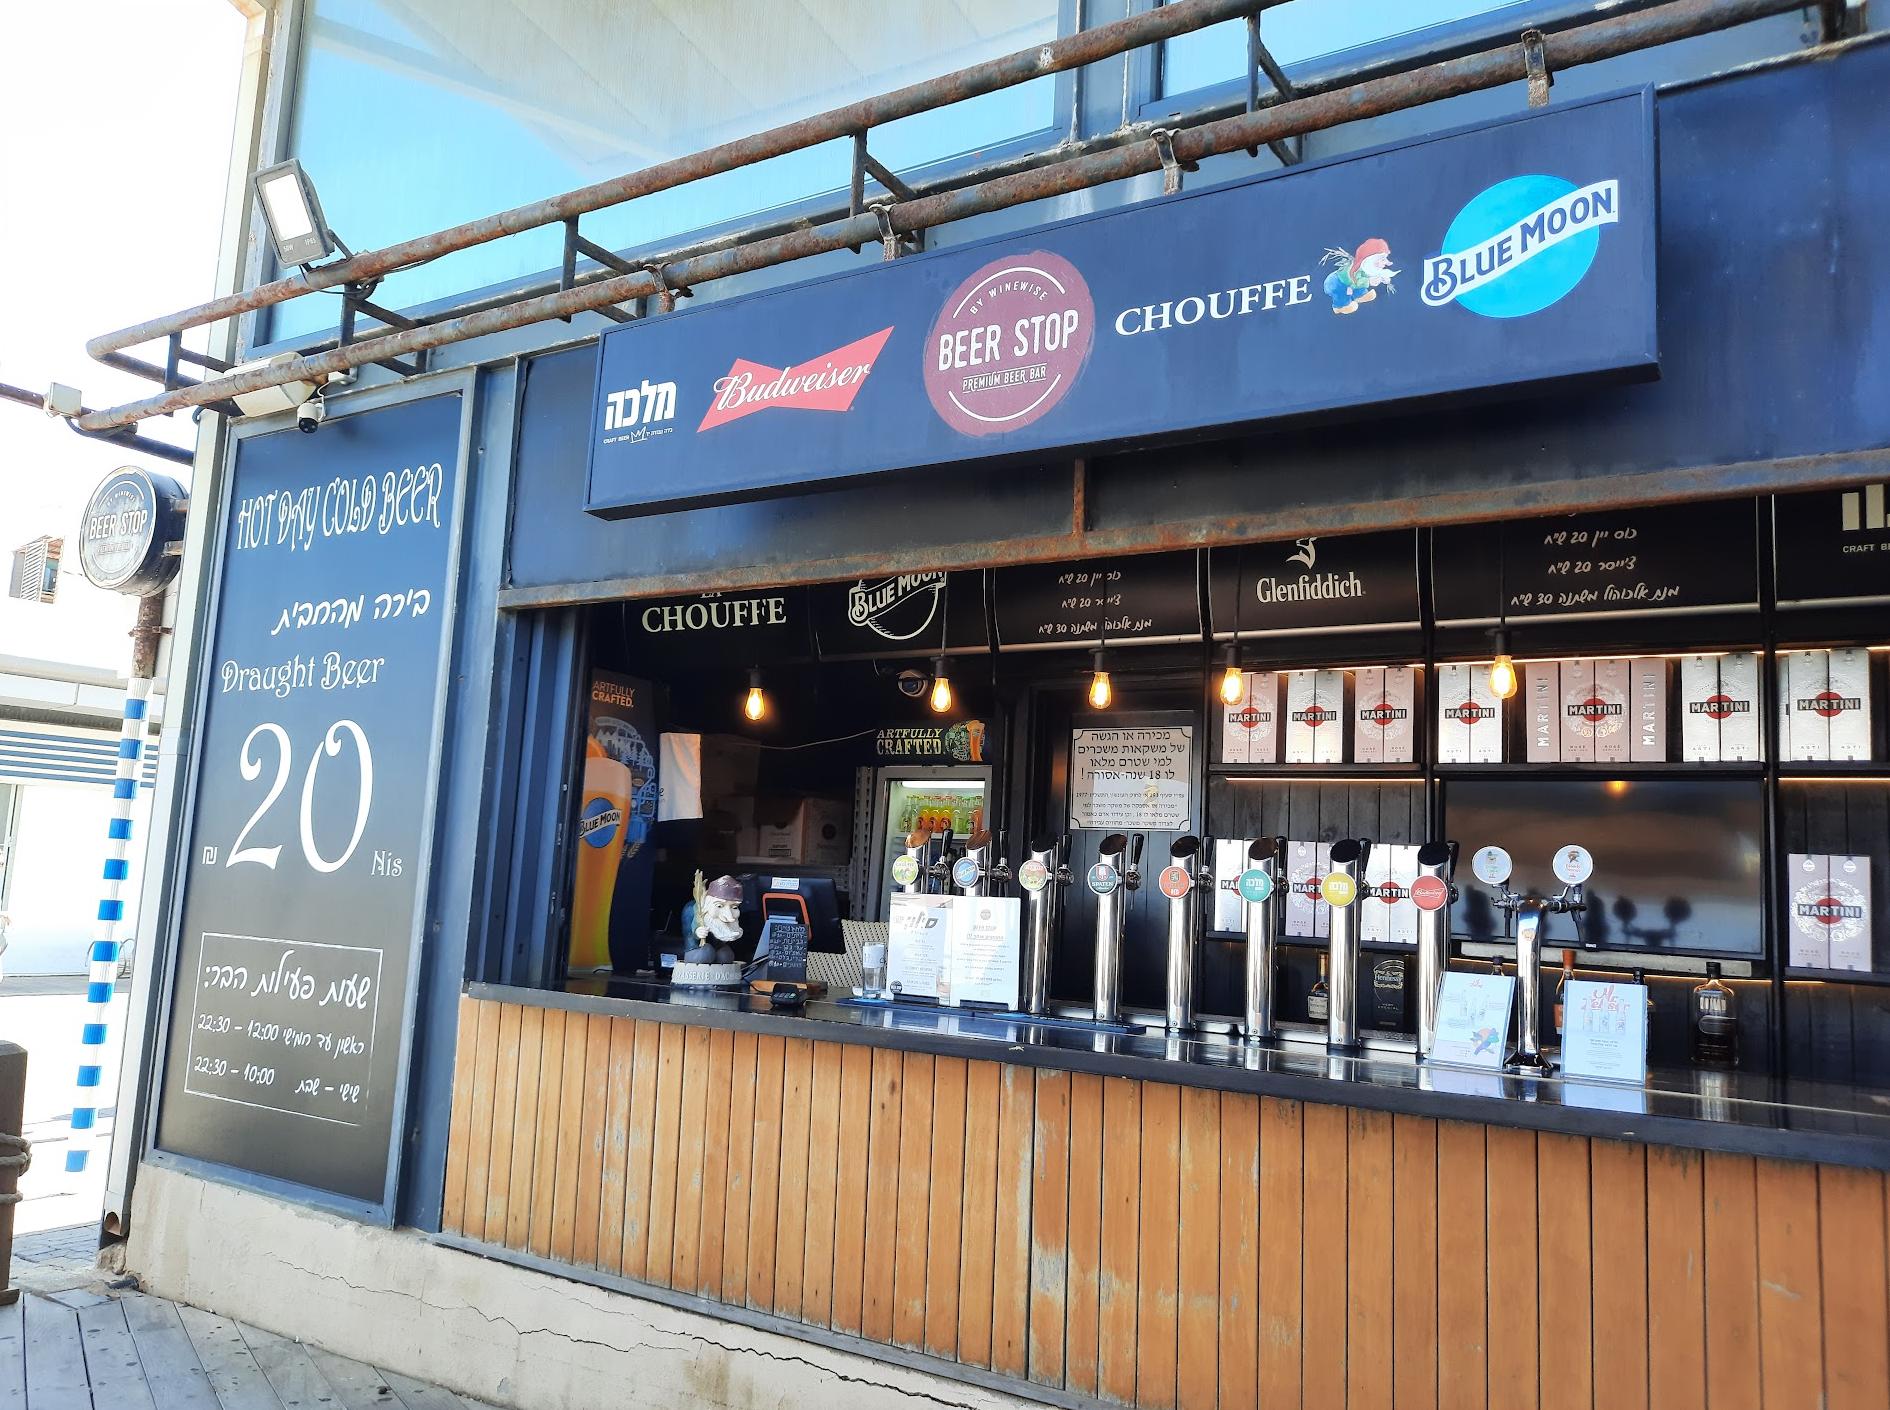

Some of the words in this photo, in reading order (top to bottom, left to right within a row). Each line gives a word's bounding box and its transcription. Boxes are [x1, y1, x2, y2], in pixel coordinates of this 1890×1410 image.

[1428, 234, 1513, 299] BLUE
[1518, 187, 1613, 247] MOON
[970, 298, 984, 314] BY
[988, 280, 1048, 301] WINEWISE
[1114, 274, 1313, 336] CHOUFFE
[938, 324, 1001, 370] BEER
[1014, 310, 1078, 357] STOP
[712, 362, 870, 411] Budweiser
[962, 372, 1000, 392] PREMIUM
[1004, 369, 1028, 384] BEER
[1030, 366, 1046, 380] BAR
[604, 380, 677, 430] מלכה
[236, 490, 278, 550] HOT
[278, 486, 319, 552] DAY
[322, 474, 377, 538] COLD
[378, 462, 444, 536] BEER
[90, 514, 116, 540] BEER
[121, 510, 148, 534] STOP
[1614, 528, 1637, 539] כוס
[1570, 532, 1588, 542] 20
[1592, 530, 1608, 548] יין
[1843, 544, 1874, 553] CRAFT
[1574, 562, 1592, 574] 20
[1076, 574, 1088, 583] 20
[1090, 572, 1102, 587] יין
[1256, 571, 1363, 602] Glenfiddich
[1536, 594, 1554, 605] 30
[1558, 590, 1598, 606] משתנה
[1604, 582, 1648, 600] אלכוהול
[1648, 585, 1680, 600] מנת
[373, 588, 432, 621] בירה
[852, 583, 895, 621] BLUE
[1080, 598, 1091, 608] 20
[271, 594, 366, 636] מהחבית
[642, 598, 786, 632] CHOUFFE
[1056, 624, 1067, 633] 30
[1070, 621, 1098, 634] משתנה
[1131, 619, 1152, 631] מנת
[221, 655, 316, 698] Draught
[320, 651, 386, 690] Beer
[592, 680, 636, 698] ARTFULLY
[592, 690, 634, 708] CRAFTED.
[1691, 702, 1748, 712] MARTINI
[1798, 698, 1860, 710] MARTINI
[1230, 713, 1270, 722] MARTINI
[1292, 712, 1336, 721] MARTINI
[1362, 710, 1406, 720] MARTINI
[1446, 708, 1494, 718] MARTINI
[1537, 678, 1549, 748] MARTINI
[1569, 705, 1621, 715] MARTINI
[1642, 674, 1656, 746] MARTINI
[876, 728, 943, 739] ARTFULLY
[1091, 732, 1119, 741] הגשה
[1122, 732, 1134, 740] או
[1137, 731, 1170, 740] מכירה
[876, 739, 946, 755] CRAFTED.
[1078, 745, 1118, 754] משכרים
[1121, 744, 1166, 756] משקאות
[1170, 742, 1185, 753] של
[1090, 757, 1115, 767] מלאו
[1119, 758, 1150, 767] שטרם
[1154, 756, 1172, 766] למי
[1149, 770, 1160, 780] 18
[1165, 770, 1175, 779] לו
[226, 719, 374, 874] 20
[370, 850, 402, 878] Nis
[579, 818, 599, 836] BLUE
[600, 811, 621, 826] MOON
[1370, 887, 1408, 898] MARTIN
[1800, 904, 1861, 918] MARTINI
[204, 965, 248, 990] הבר:
[250, 950, 316, 1000] פעילות
[318, 973, 371, 1009] שעות
[198, 1014, 231, 1034] 22:30
[247, 1019, 279, 1041] 12:00
[282, 1027, 311, 1048] חמישי
[316, 1034, 332, 1052] עד
[334, 1036, 365, 1060] ראשון
[194, 1056, 226, 1076] 22:30
[244, 1063, 275, 1085] 10:00
[294, 1078, 320, 1096] שבת
[339, 1084, 360, 1104] שישי
